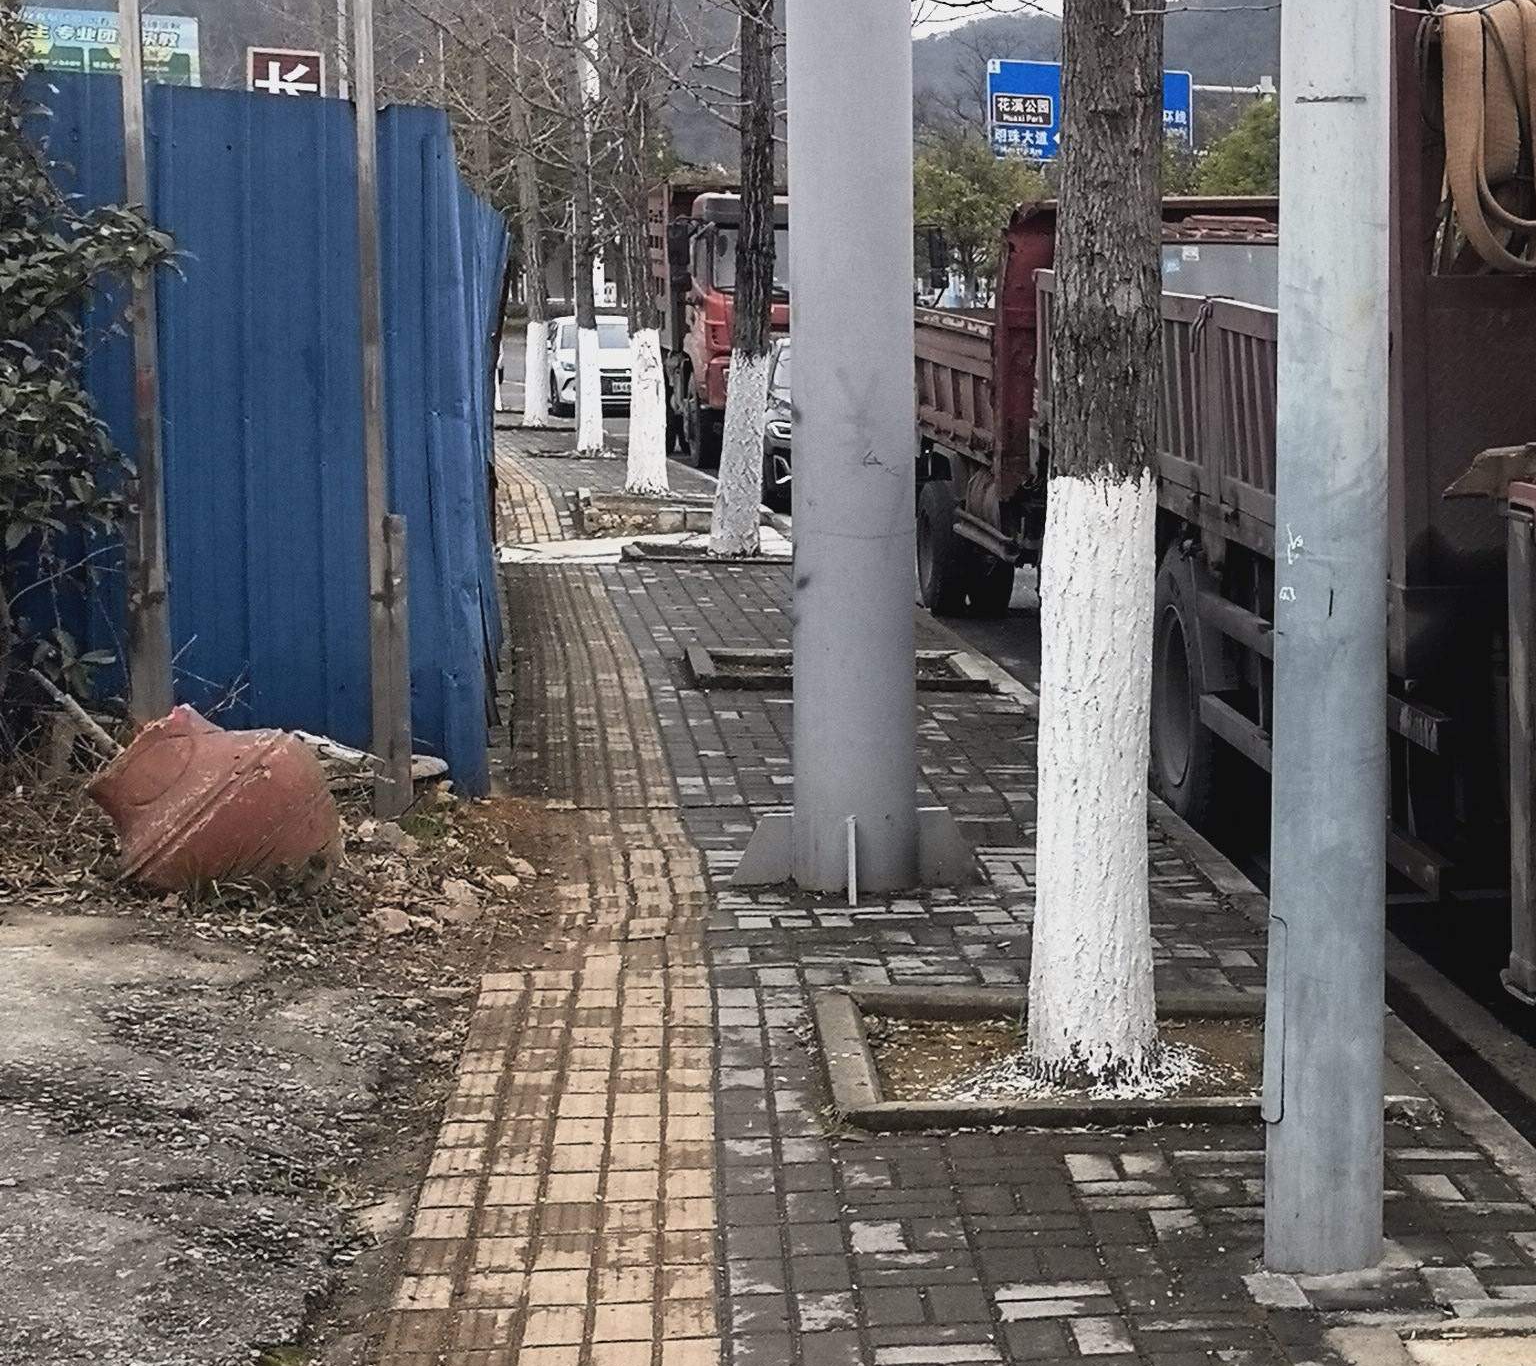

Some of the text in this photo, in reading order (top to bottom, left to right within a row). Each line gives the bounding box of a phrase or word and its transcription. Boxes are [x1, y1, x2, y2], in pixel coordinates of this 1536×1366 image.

[997, 97, 1050, 114] 花溪公园
[994, 128, 1049, 145] 明珠大道
